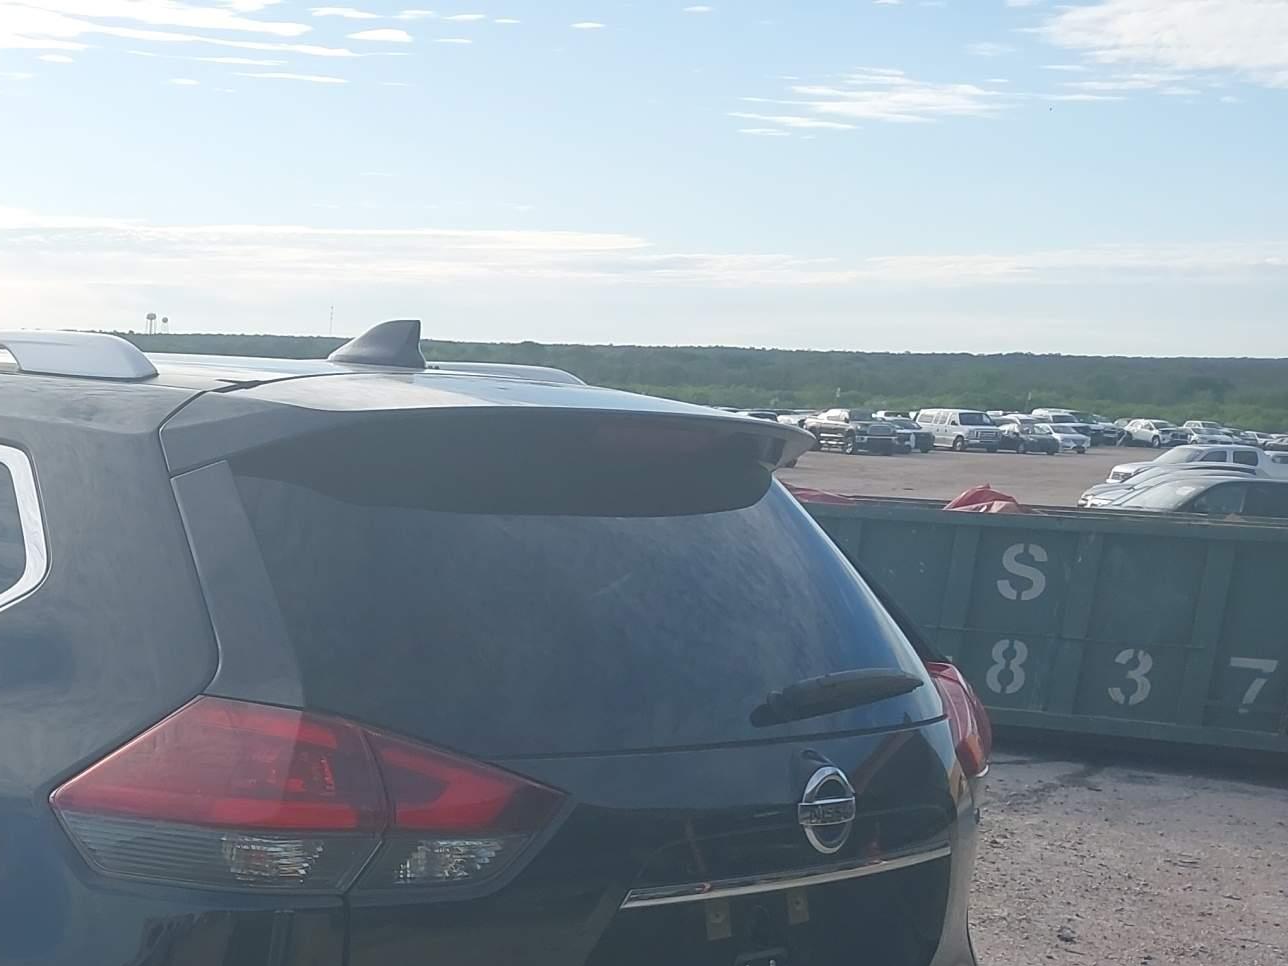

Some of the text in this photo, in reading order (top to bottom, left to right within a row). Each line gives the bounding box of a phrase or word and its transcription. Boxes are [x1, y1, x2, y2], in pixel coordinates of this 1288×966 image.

[996, 542, 1048, 600] S
[986, 639, 1279, 714] 8 3 7
